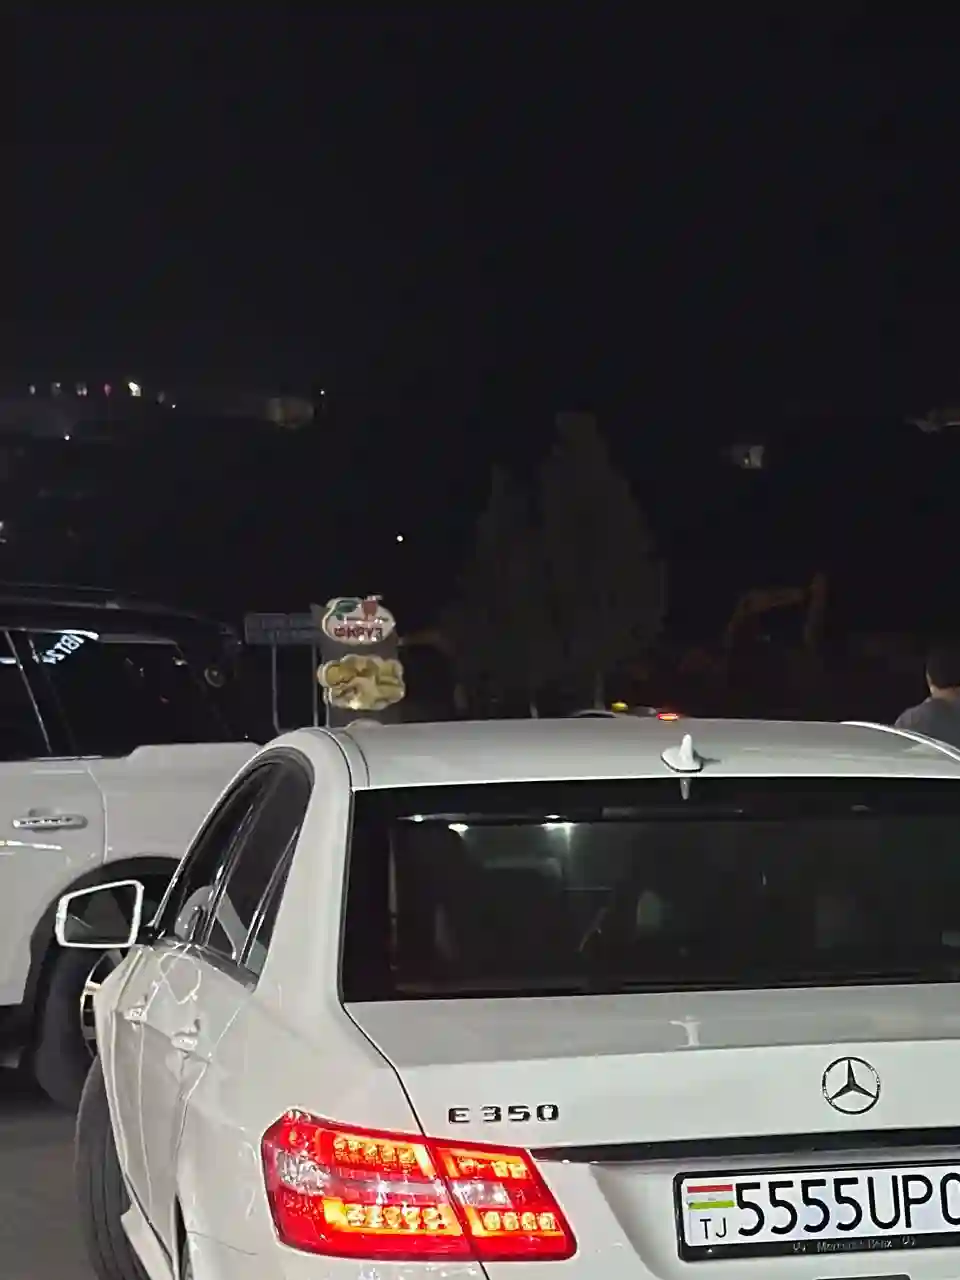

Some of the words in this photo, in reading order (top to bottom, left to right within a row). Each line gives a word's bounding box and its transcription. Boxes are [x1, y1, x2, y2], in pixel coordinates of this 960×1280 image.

[448, 1107, 470, 1124] E
[480, 1104, 559, 1122] 350
[699, 1217, 727, 1239] TJ
